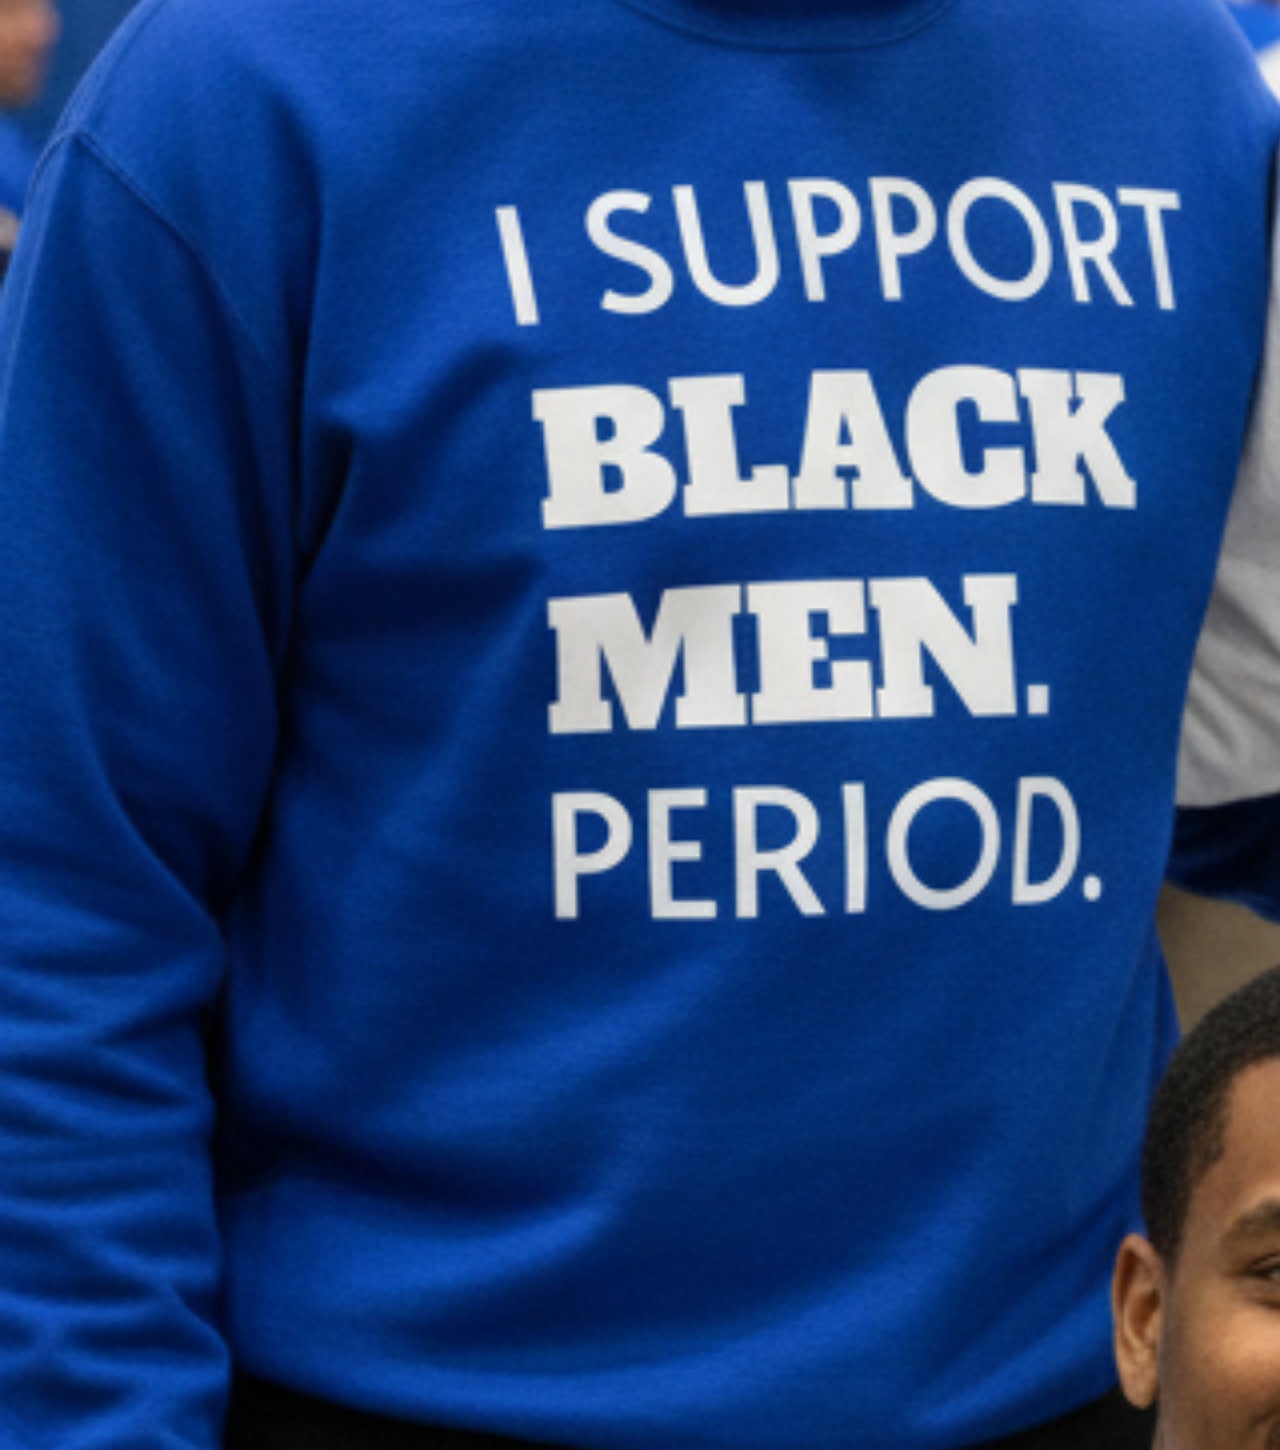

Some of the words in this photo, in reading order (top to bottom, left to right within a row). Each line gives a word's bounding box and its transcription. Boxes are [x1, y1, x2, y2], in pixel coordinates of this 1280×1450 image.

[494, 204, 540, 327] I
[584, 175, 1182, 315] SUPPORT
[530, 363, 1137, 531] BLACK
[546, 572, 1050, 735] MEN.
[551, 775, 1102, 921] PERIOD.
